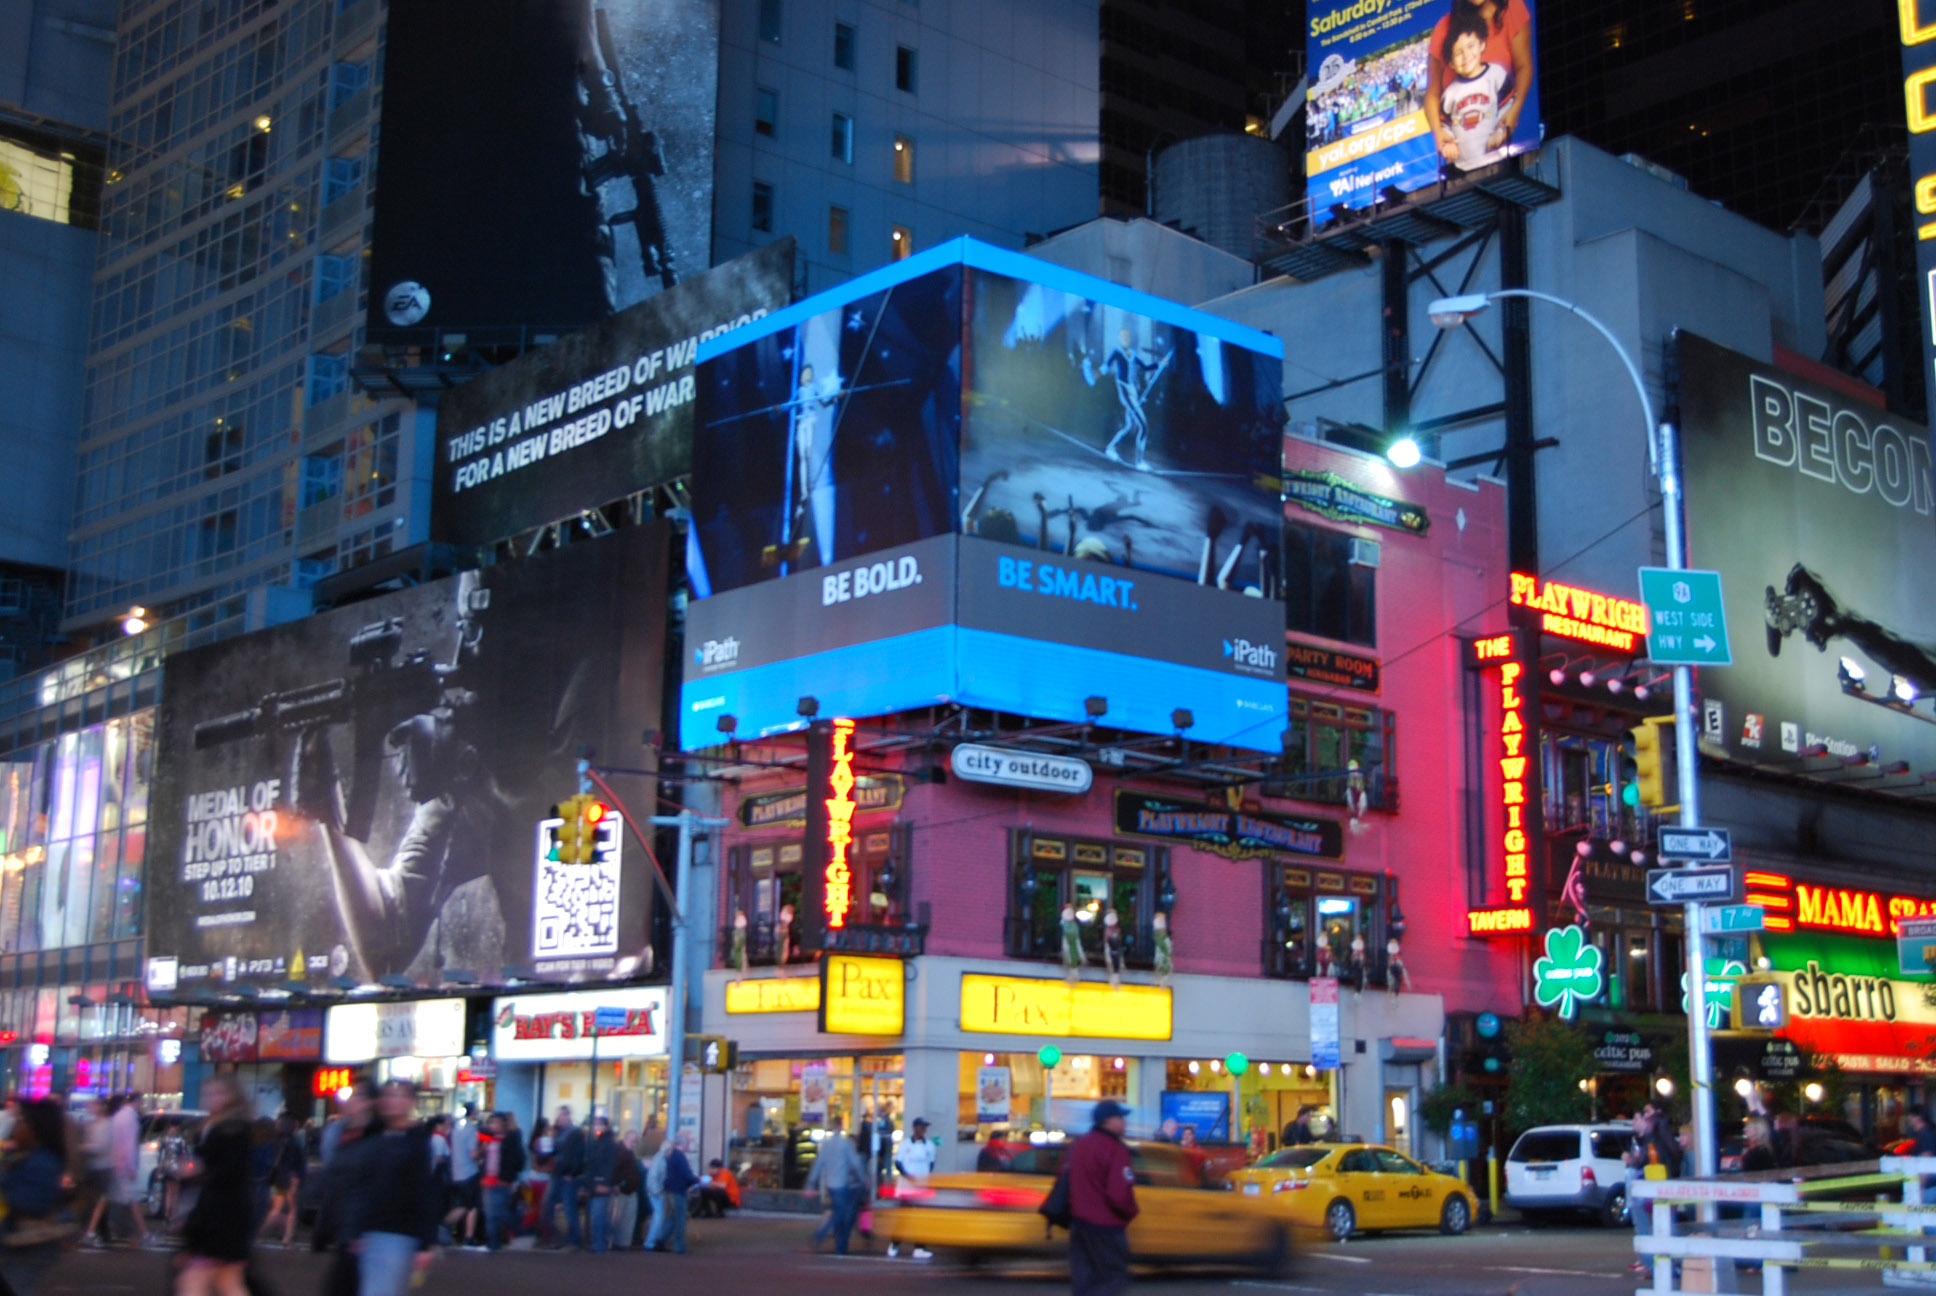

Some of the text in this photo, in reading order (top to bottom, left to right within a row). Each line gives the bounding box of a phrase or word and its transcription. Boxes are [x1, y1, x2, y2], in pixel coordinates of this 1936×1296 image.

[1354, 162, 1405, 189] Network
[450, 350, 664, 463] THIS IS A NEW BREED OF
[454, 458, 490, 493] FOR
[490, 452, 505, 479] A
[506, 432, 549, 472] NEW
[549, 408, 612, 456] BREED
[614, 394, 644, 430] OF
[822, 555, 923, 607] BE BOLD.
[998, 556, 1139, 612] BE SMART.
[1673, 584, 1689, 599] 9A
[1543, 613, 1634, 651] RESTAURANT
[1655, 610, 1715, 628] WEST SIDE
[703, 636, 739, 665] iPath
[1233, 638, 1275, 669] iPath
[1474, 636, 1511, 661] THE
[1659, 634, 1683, 649] HWY
[1286, 646, 1374, 676] PARTY ROOM
[1707, 710, 1719, 731] E
[966, 751, 1080, 782] city outdoor
[1500, 661, 1526, 902] PLAYWRIGHT
[187, 778, 281, 823] MEDAL OF
[185, 809, 278, 863] HONOR
[1669, 836, 1718, 851] ONE WAY
[184, 861, 211, 881] STEP
[211, 859, 228, 878] UP
[228, 857, 243, 875] TO
[243, 853, 269, 873] TIER
[203, 874, 254, 901] 10.12.10
[1660, 878, 1721, 894] ONE WAY
[1467, 908, 1531, 933] TAVERN
[1724, 908, 1737, 928] 7
[1796, 885, 1883, 932] MAMA
[839, 961, 891, 1001] Pax
[1795, 960, 1897, 1022] sbarro
[992, 984, 1050, 1026] Pax
[513, 1010, 576, 1040] RAY'S
[1875, 1057, 1910, 1070] SALAD
[1838, 1202, 1875, 1211] CAUTION
